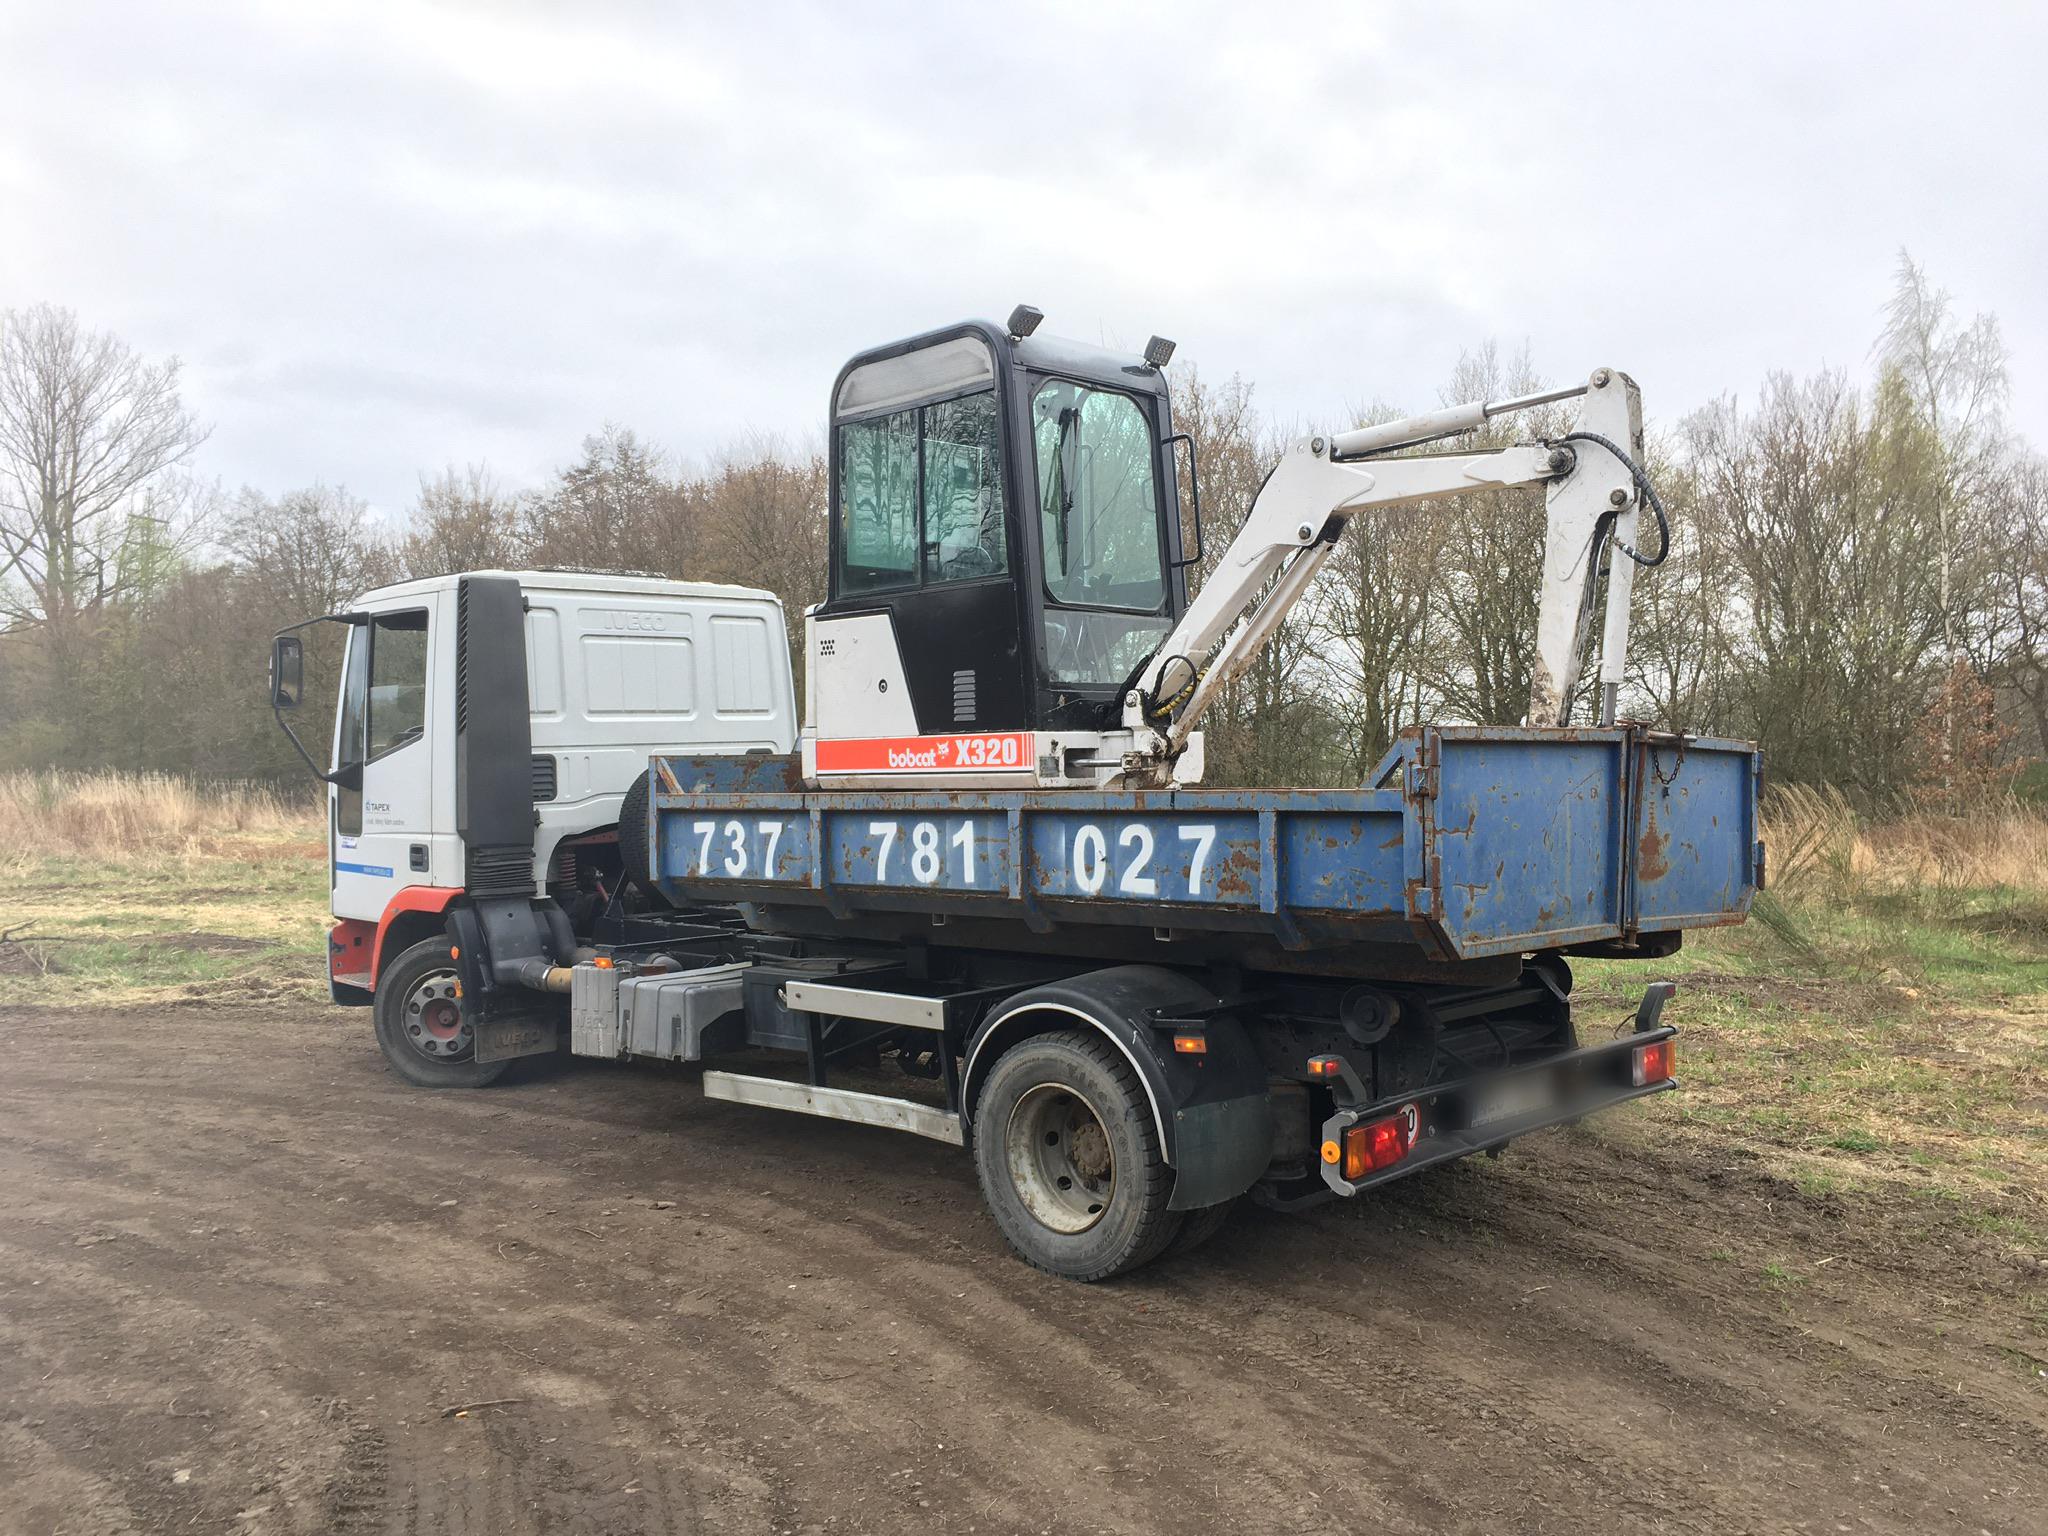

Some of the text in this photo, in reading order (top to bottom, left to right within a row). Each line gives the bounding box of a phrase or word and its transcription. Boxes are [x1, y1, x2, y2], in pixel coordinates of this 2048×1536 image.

[604, 610, 666, 632] IVECO
[888, 738, 1018, 768] bobcat X320
[371, 803, 390, 812] TAPEX
[694, 820, 1217, 896] 737 781 027
